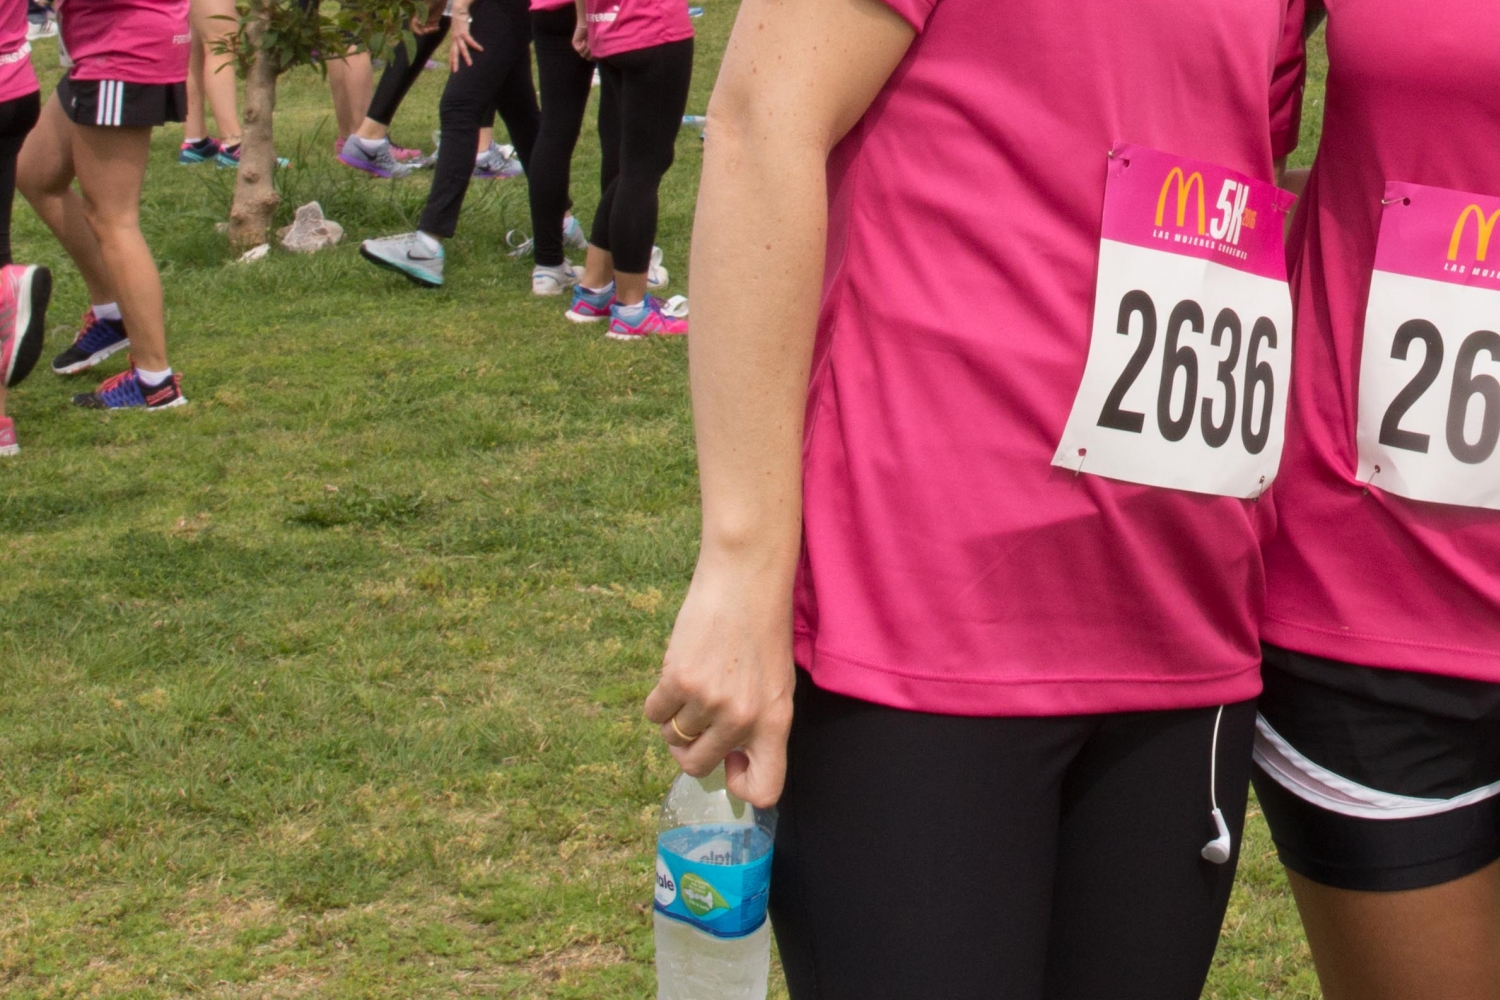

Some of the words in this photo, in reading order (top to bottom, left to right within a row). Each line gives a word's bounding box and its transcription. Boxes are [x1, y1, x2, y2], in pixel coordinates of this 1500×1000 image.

[1210, 178, 1250, 246] 5K
[1242, 207, 1256, 230] 2016
[1153, 229, 1169, 240] LAS
[1174, 233, 1215, 249] MUJERES
[1218, 243, 1247, 260] CORREMOS
[1444, 263, 1465, 273] LAS
[1096, 289, 1278, 455] 2636
